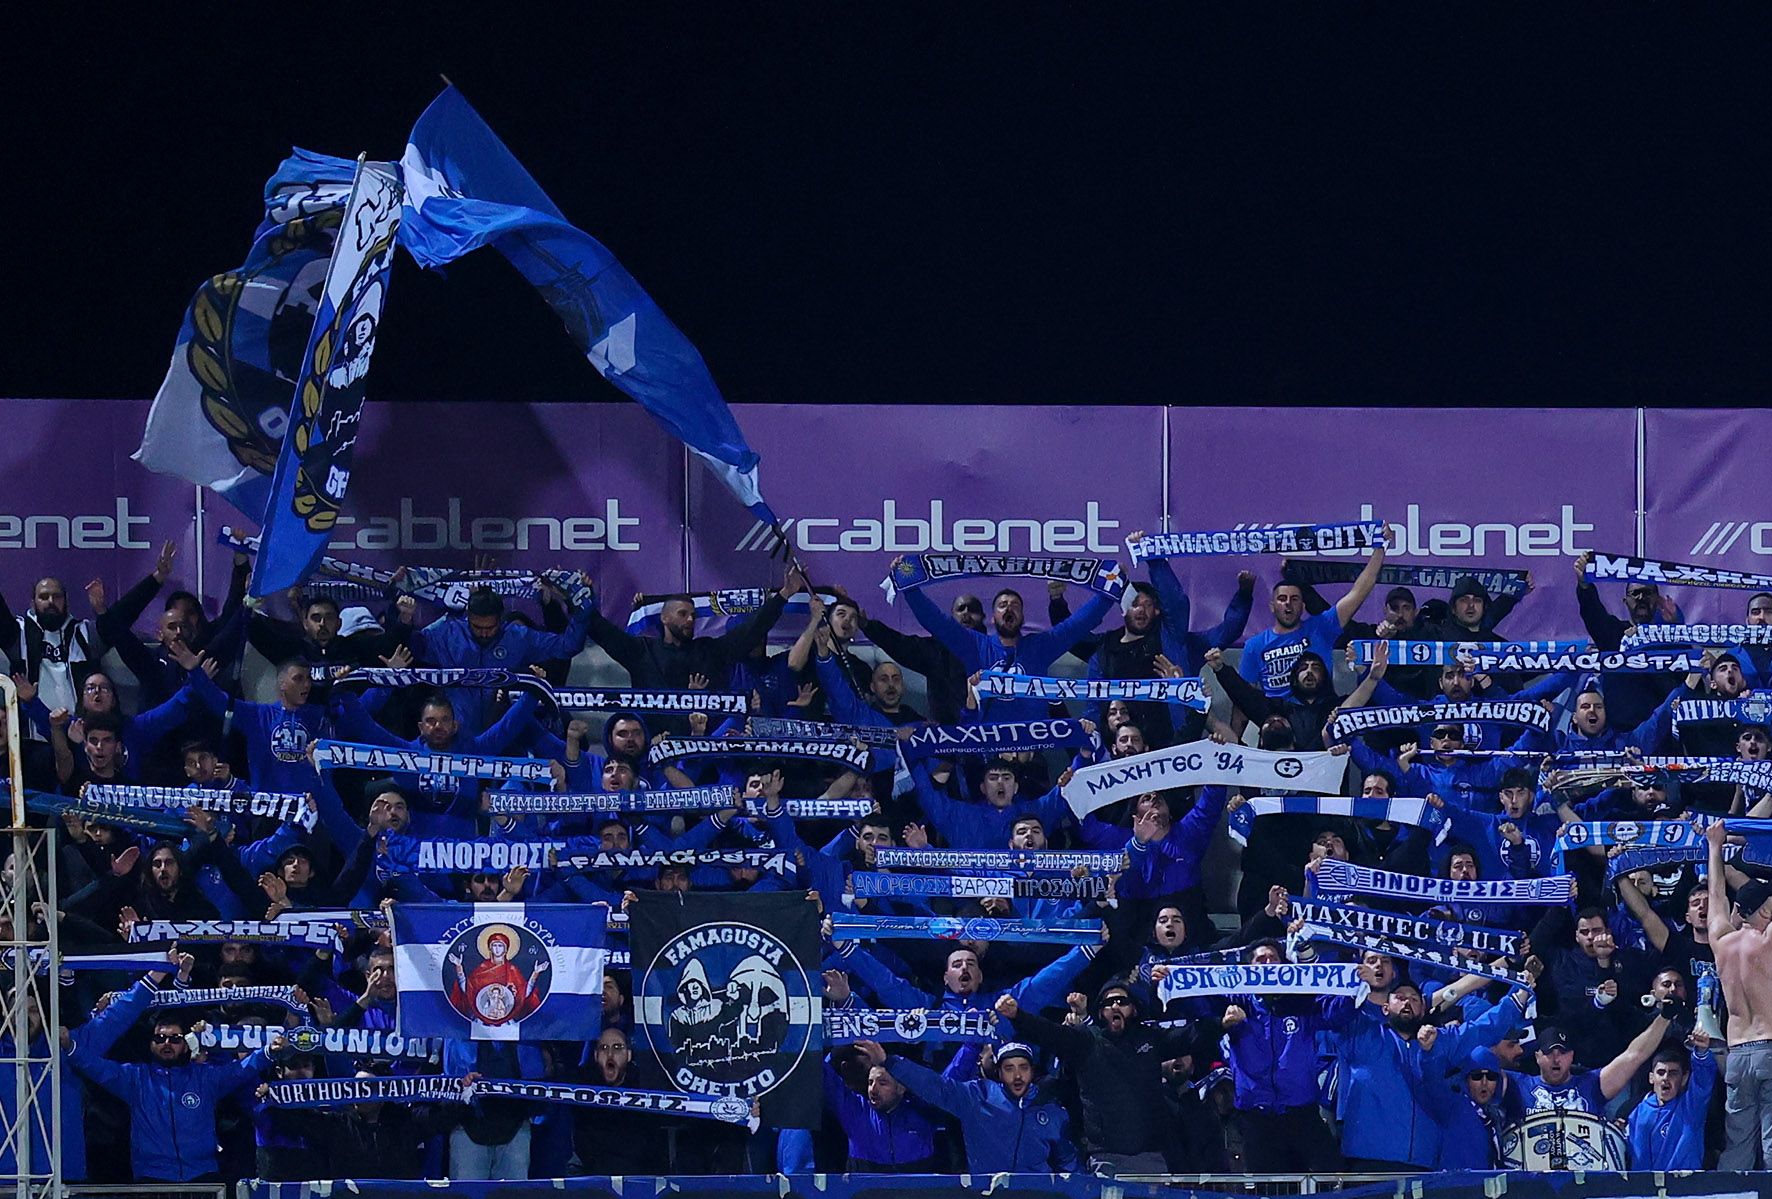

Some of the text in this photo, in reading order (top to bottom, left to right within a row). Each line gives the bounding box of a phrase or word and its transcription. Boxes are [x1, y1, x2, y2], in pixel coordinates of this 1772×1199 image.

[797, 499, 1119, 553] cablenet
[1272, 504, 1594, 556] blenet
[1317, 524, 1375, 549] CITY
[988, 673, 1201, 700] MAXHTEC
[620, 693, 747, 714] FAMAGUSTA
[909, 719, 1073, 749] MAXHTEC
[1333, 705, 1420, 740] FREEDOM
[1434, 702, 1551, 733] FAMAGUSTA
[331, 744, 552, 778] MAXHTEC
[647, 738, 730, 765] REEDOM
[1086, 753, 1204, 795] MAXHTEC
[1289, 901, 1430, 942] MAXHTEC
[664, 927, 784, 966] FAMAGUSTA
[324, 1027, 428, 1058] UNION
[268, 1077, 463, 1104] NORTHOSIS FAMAGUS
[676, 1067, 776, 1098] GHETTO
